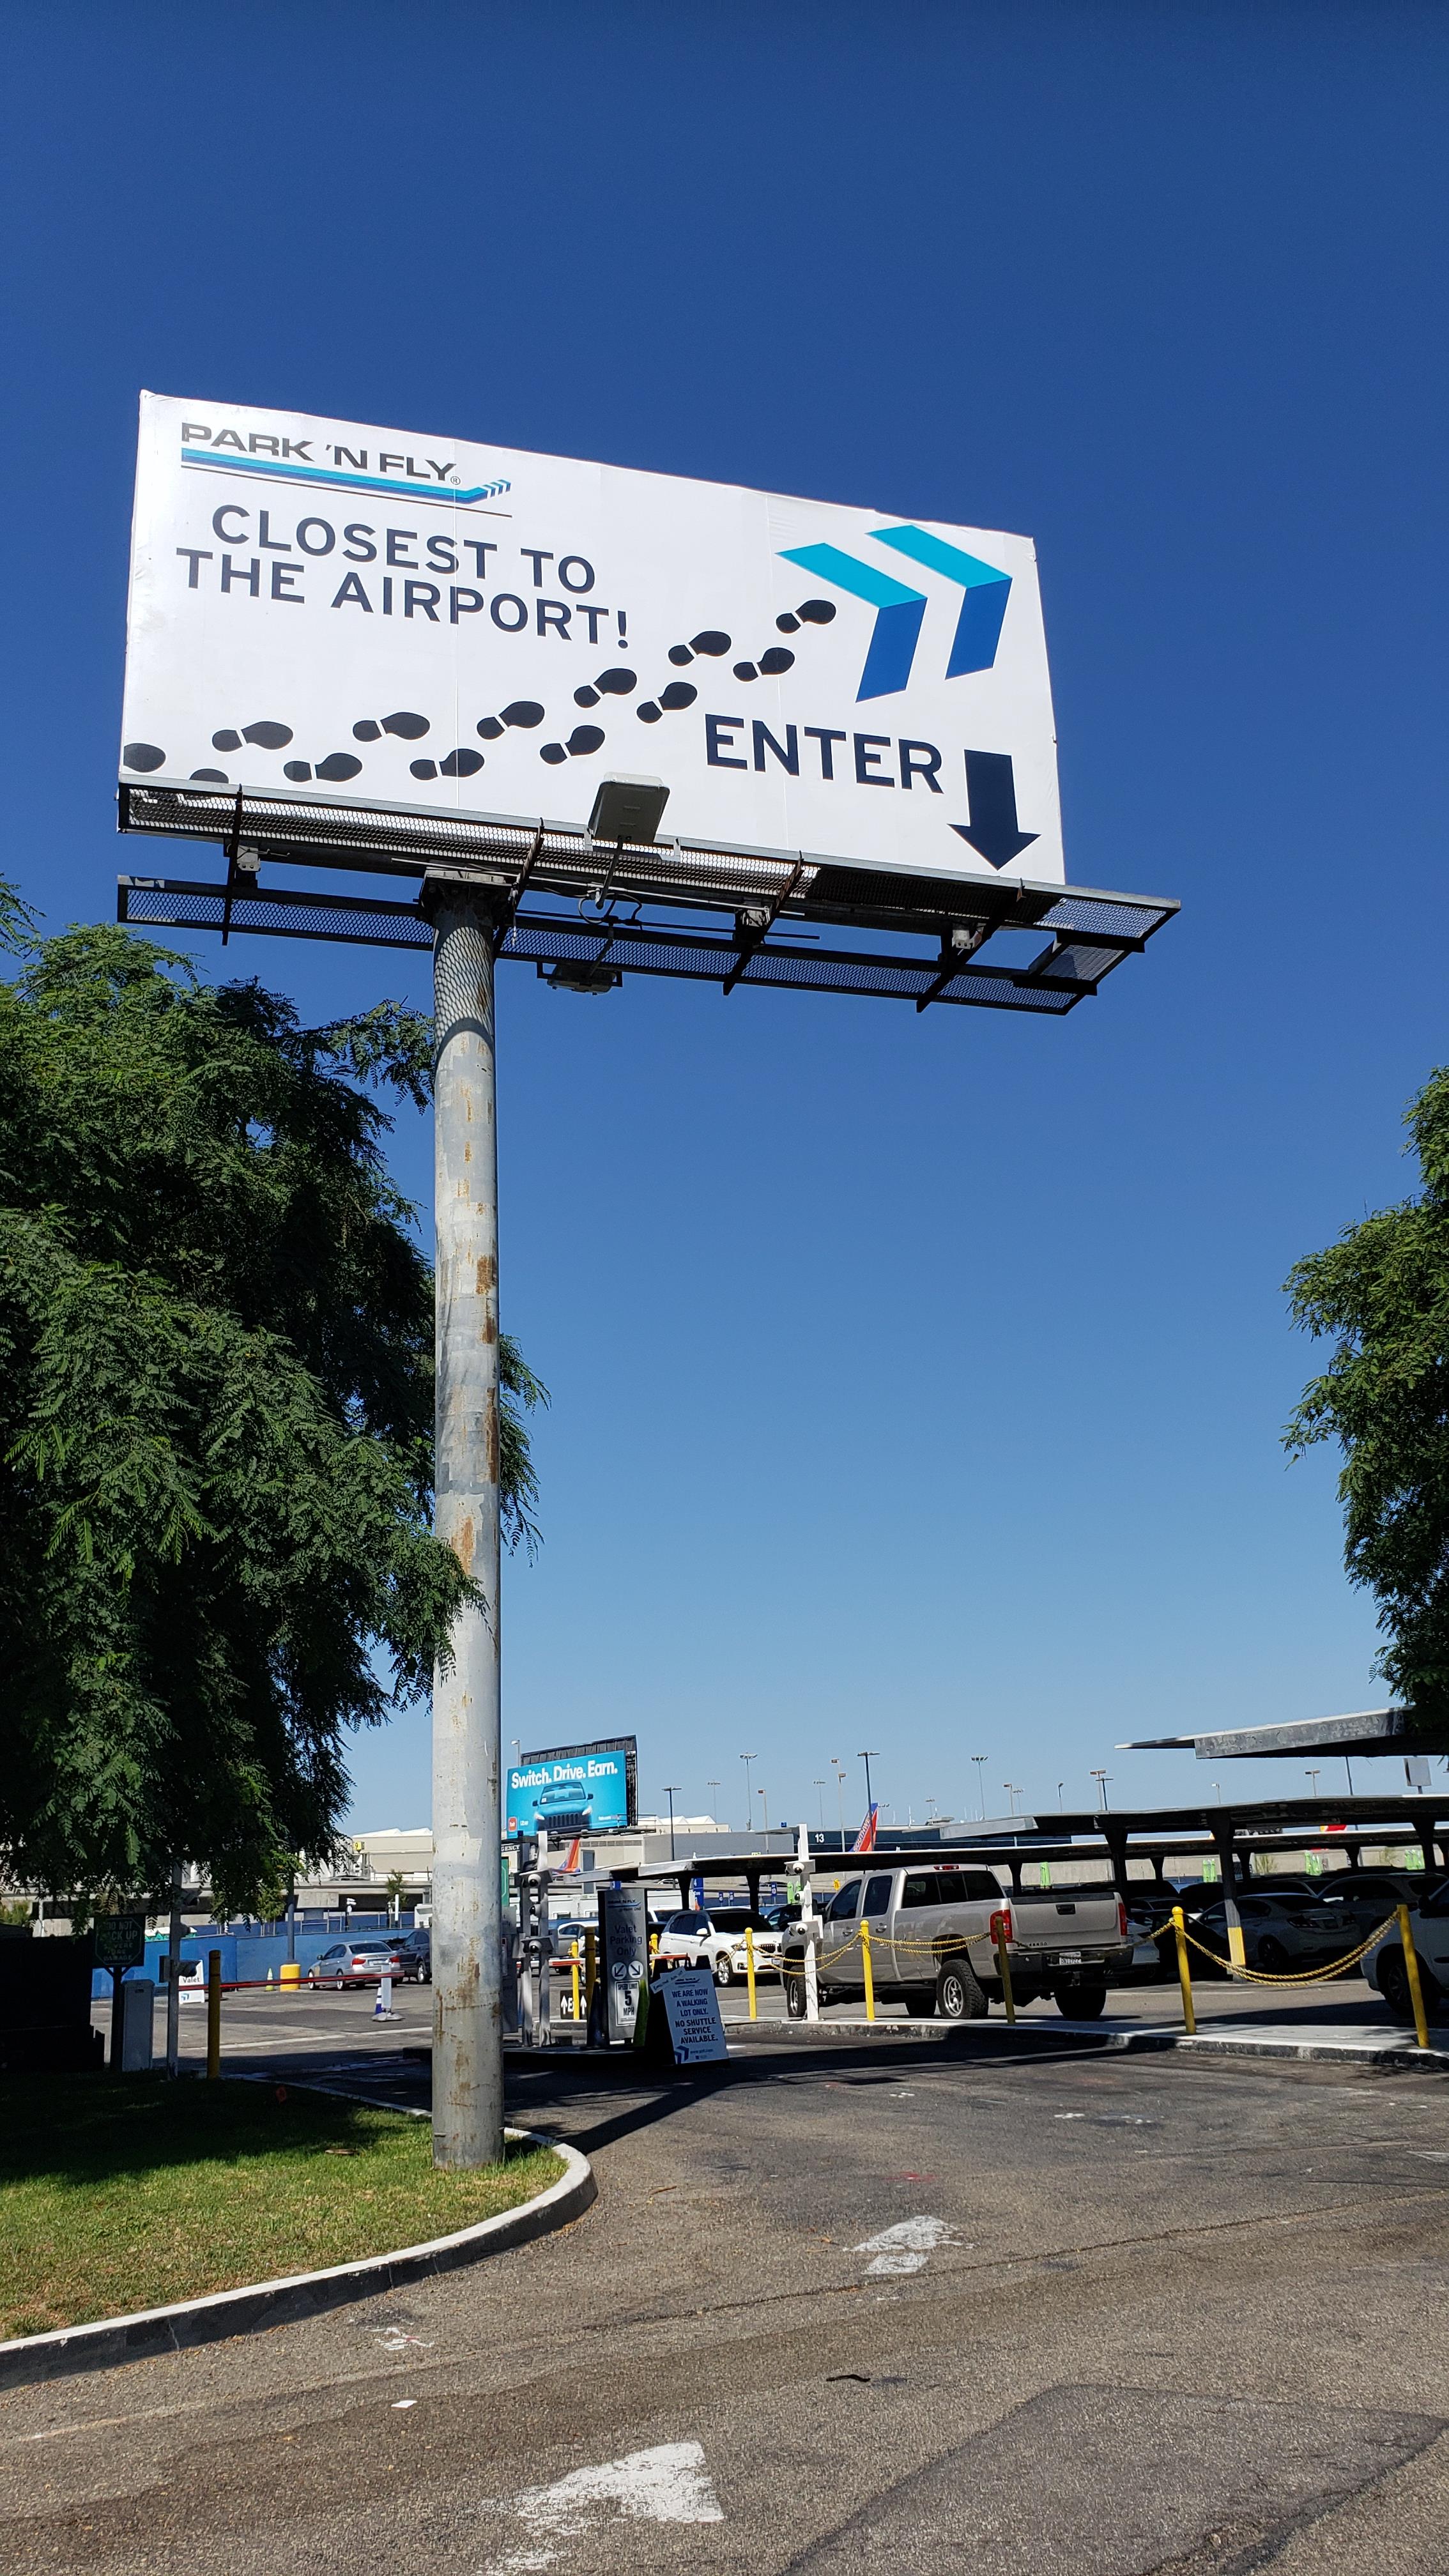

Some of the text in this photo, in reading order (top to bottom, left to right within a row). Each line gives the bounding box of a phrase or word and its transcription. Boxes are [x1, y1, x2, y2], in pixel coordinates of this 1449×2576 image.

[181, 422, 315, 462] PARK
[212, 504, 595, 594] CLOSEST TO
[176, 548, 629, 650] THE AIRPORT!
[705, 713, 945, 795] ENTER
[512, 1760, 618, 1789] Switch. Drive. Earn.
[815, 1833, 825, 1843] 13
[615, 1924, 637, 1933] Valet
[125, 1929, 138, 1940] UP
[610, 1936, 643, 1945] Parking
[617, 1947, 636, 1956] Only
[624, 1990, 632, 2006] 5
[624, 2007, 634, 2016] MPH
[692, 2007, 709, 2016] ONLY.
[686, 2017, 716, 2026] SHUTTLE
[683, 2026, 712, 2035] SERVICE
[680, 2034, 719, 2044] AVAILABLE.
